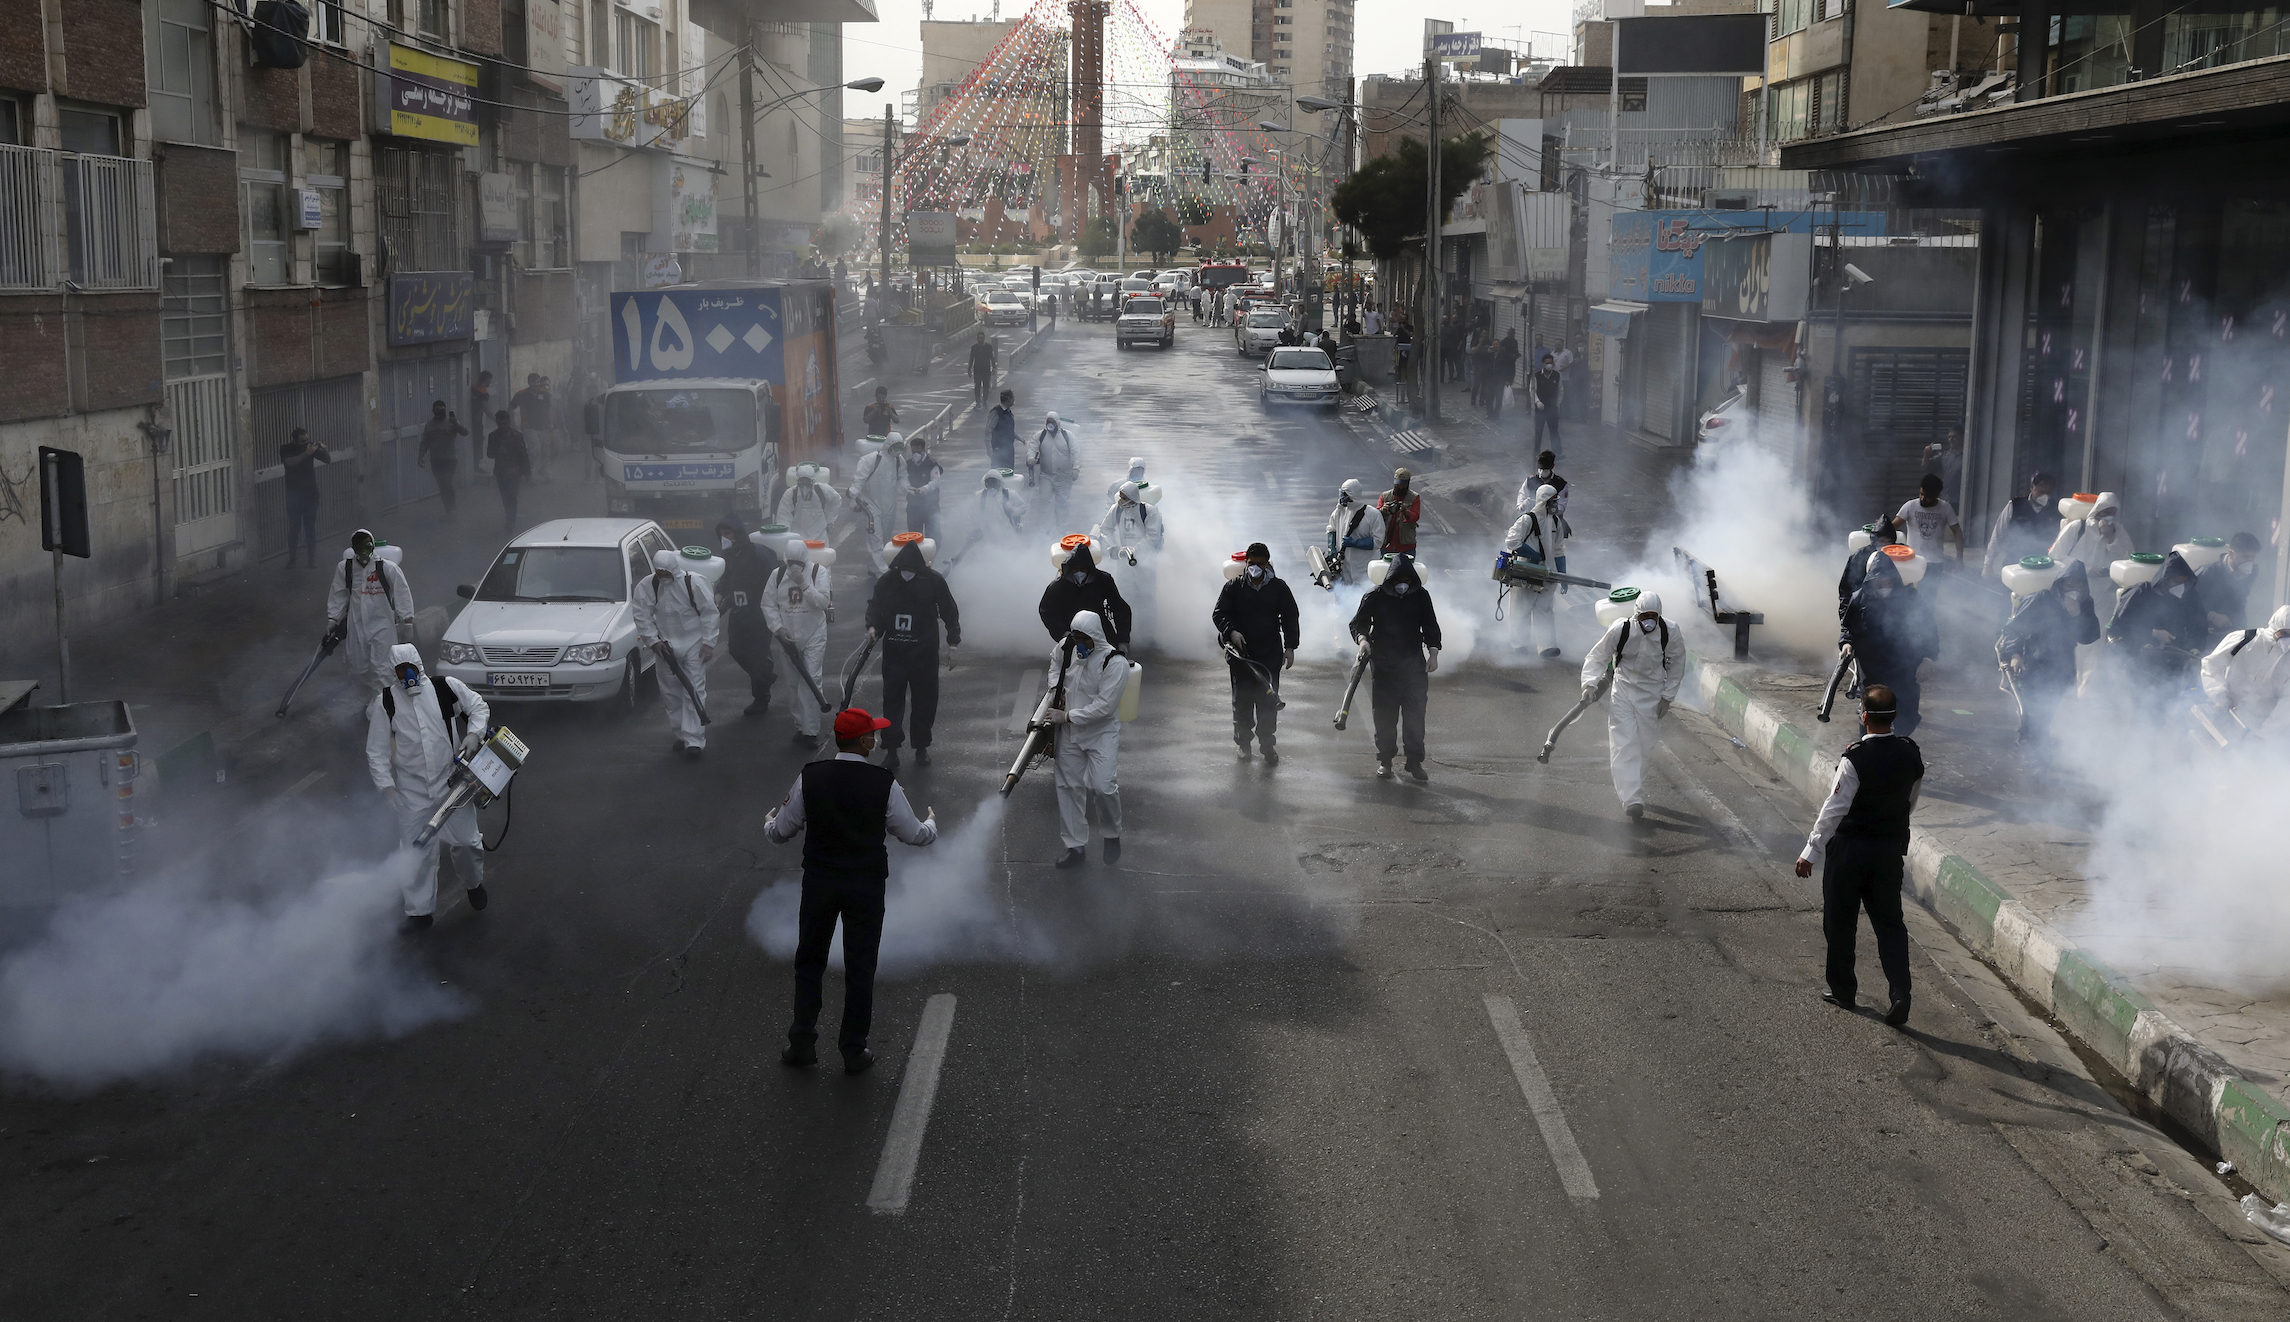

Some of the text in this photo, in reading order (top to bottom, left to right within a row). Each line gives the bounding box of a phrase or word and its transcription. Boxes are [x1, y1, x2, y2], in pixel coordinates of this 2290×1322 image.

[1450, 35, 1468, 55] ترجمه
[1467, 33, 1480, 55] دفتر
[401, 86, 472, 115] دفتر ترجمه رسمی
[1656, 219, 1700, 257] نیکتا
[646, 271, 679, 279] سید مهدی
[1654, 272, 1696, 293] nikta
[1739, 240, 1771, 314] باران
[698, 296, 745, 311] ظریف بار
[676, 465, 699, 479] بار
[701, 464, 733, 478] ظریف
